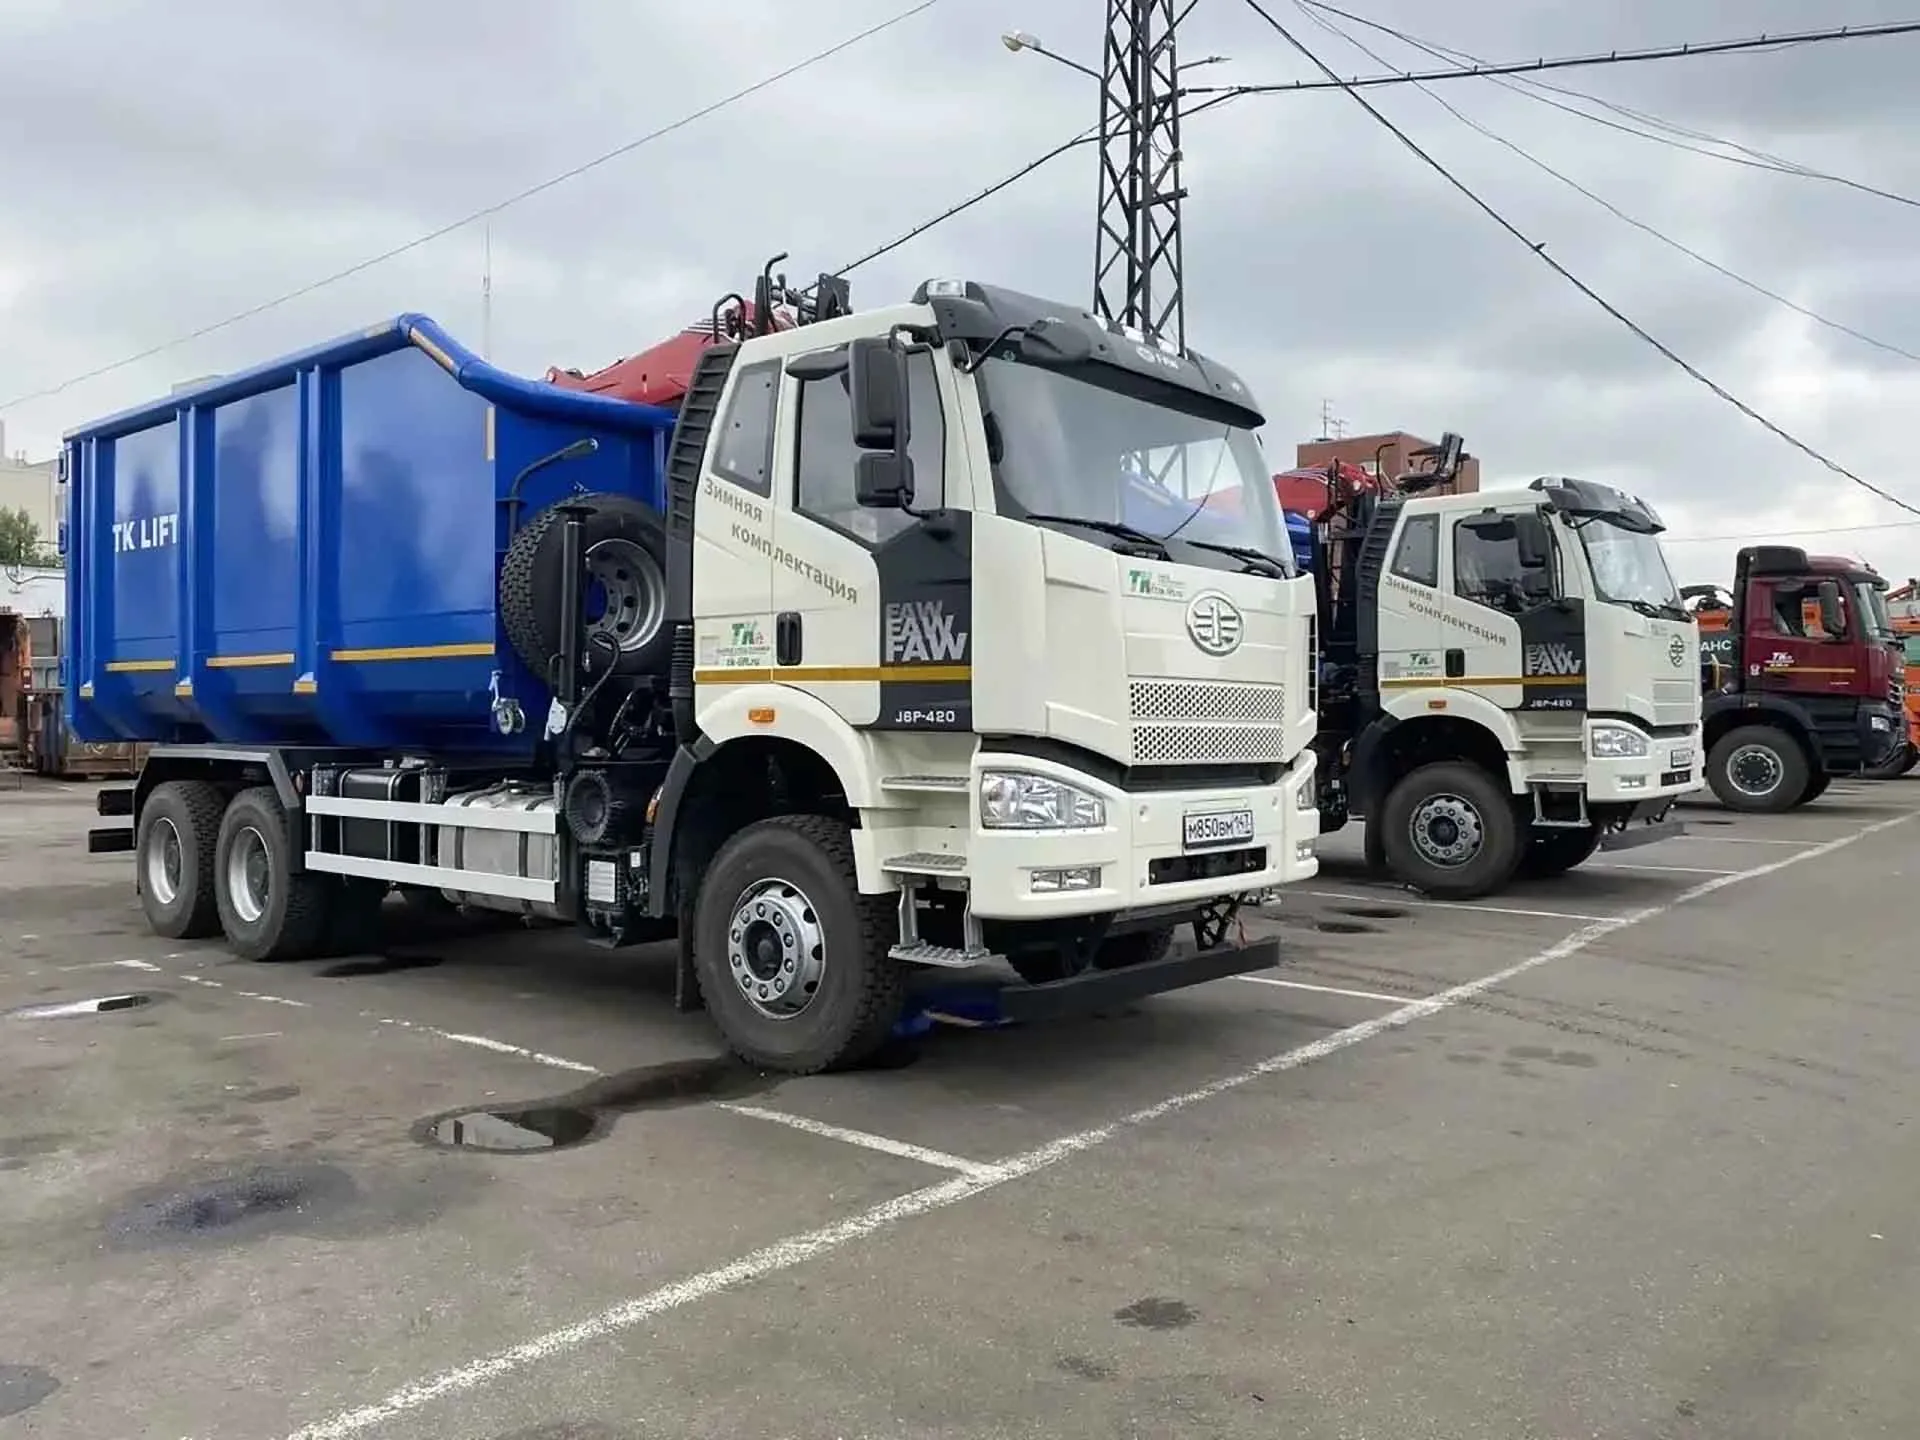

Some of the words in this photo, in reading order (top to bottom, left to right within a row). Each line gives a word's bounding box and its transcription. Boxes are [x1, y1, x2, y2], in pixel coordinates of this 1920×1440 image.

[112, 521, 136, 552] TK
[140, 514, 178, 549] LIFT
[732, 523, 858, 604] комплектация
[1408, 600, 1507, 646] комплектация
[886, 632, 968, 662] FAW
